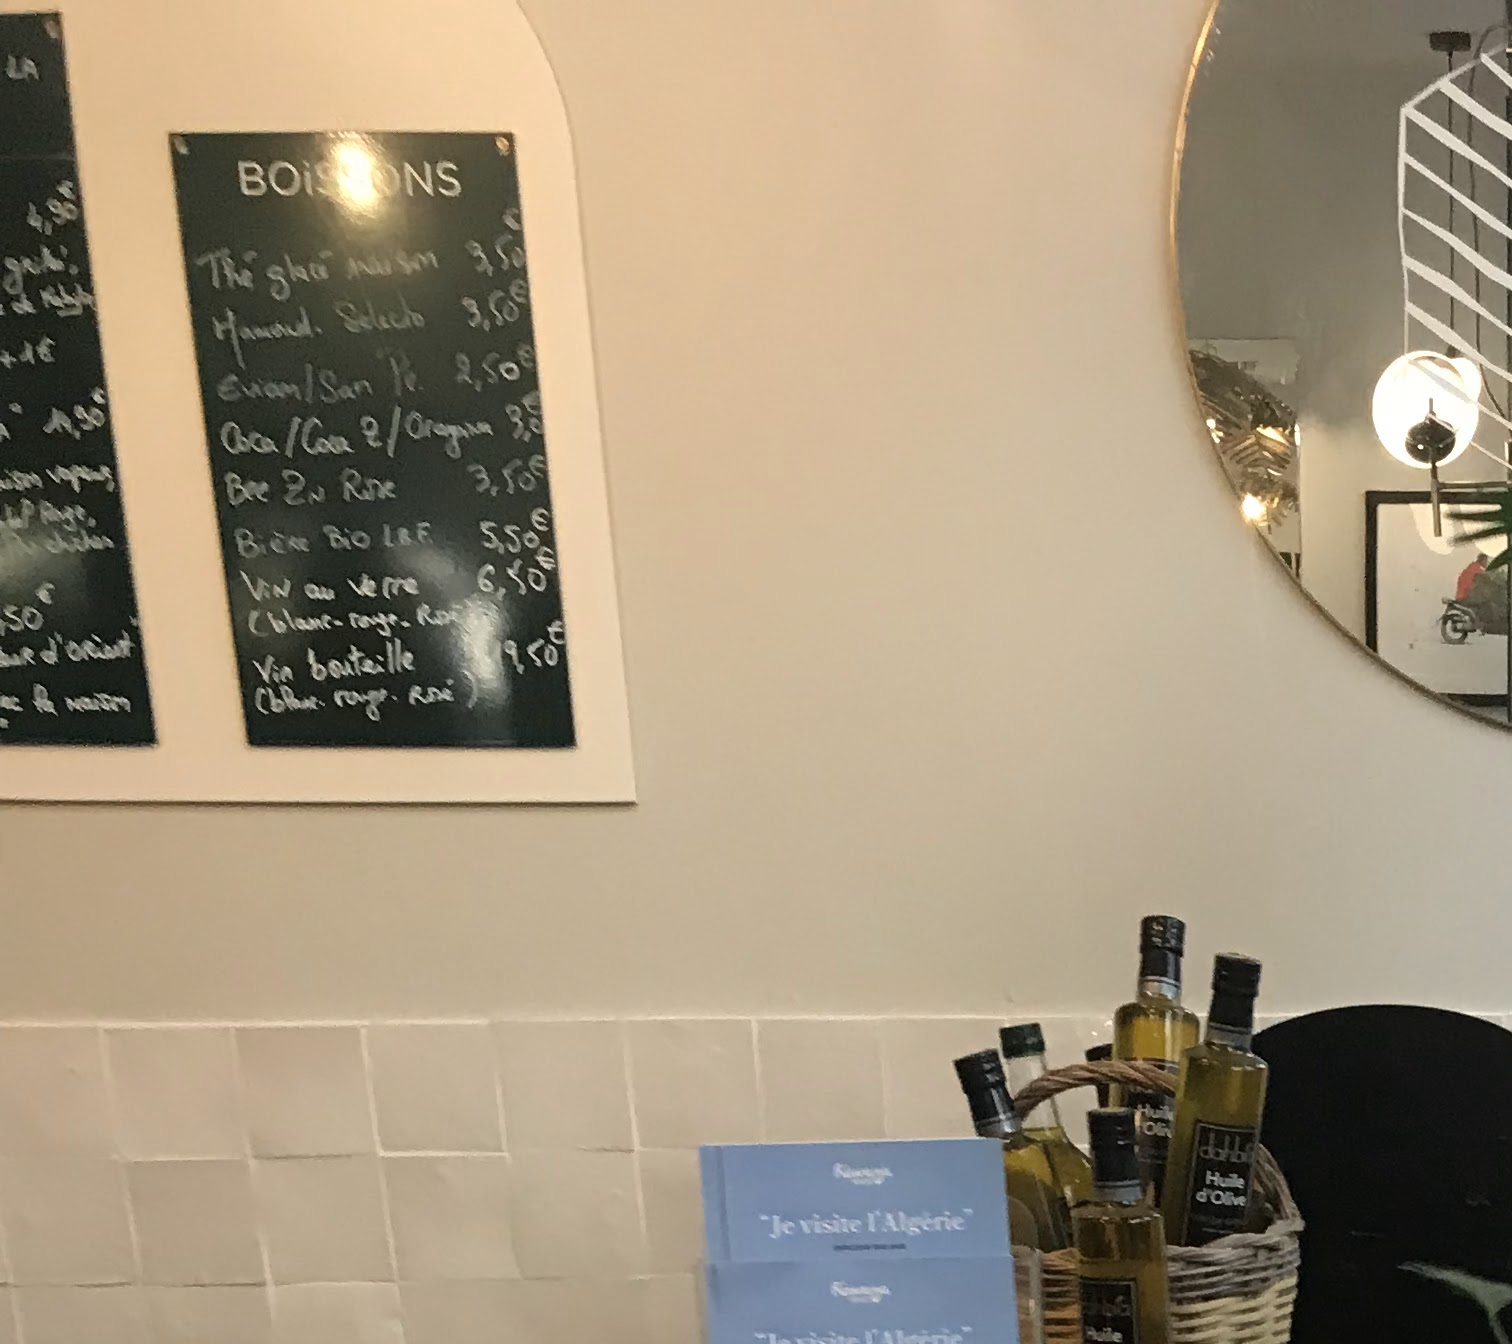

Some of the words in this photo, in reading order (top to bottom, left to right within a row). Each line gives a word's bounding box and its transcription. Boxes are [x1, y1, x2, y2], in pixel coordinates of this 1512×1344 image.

[1205, 1170, 1245, 1189] Huile
[1196, 1187, 1247, 1207] d'Olive
[800, 1212, 861, 1235] visite
